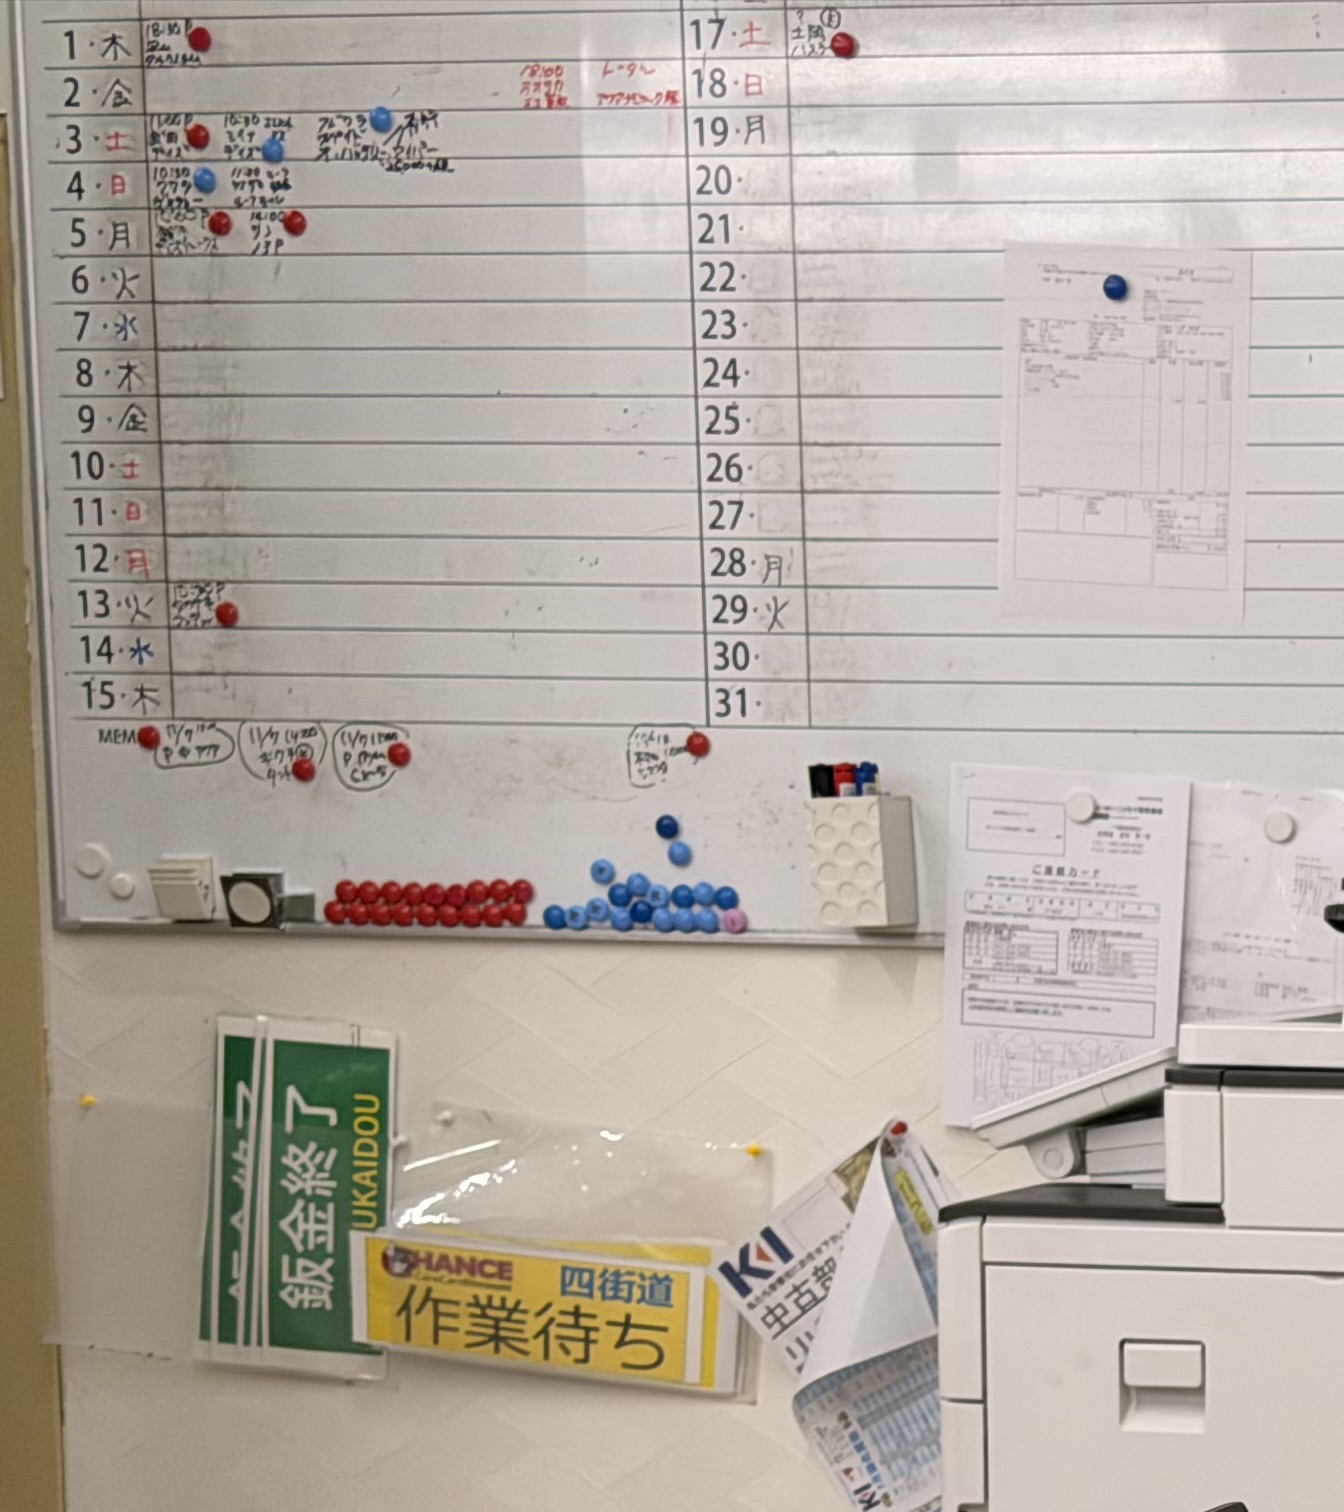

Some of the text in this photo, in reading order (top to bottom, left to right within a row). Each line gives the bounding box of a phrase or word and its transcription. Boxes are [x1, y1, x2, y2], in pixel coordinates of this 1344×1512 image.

[62, 29, 77, 61] 1
[689, 18, 726, 50] 17
[62, 75, 82, 108] 2
[692, 67, 728, 99] 18
[63, 123, 83, 156] 3
[693, 115, 730, 147] 19
[64, 169, 86, 200] 4
[695, 164, 733, 197] 20
[70, 216, 88, 246] 5
[696, 211, 732, 245] 21
[70, 264, 90, 295] 6
[698, 260, 737, 294] 22
[74, 311, 91, 340] 7
[699, 307, 739, 341] 23
[75, 357, 95, 388] 8
[702, 355, 742, 389] 24
[78, 404, 97, 433] 9
[703, 403, 743, 436] 25
[69, 450, 105, 482] 10
[705, 450, 745, 484] 26
[72, 496, 105, 526] 11
[706, 499, 745, 533] 27
[74, 543, 110, 574] 12
[709, 545, 748, 578] 28
[77, 588, 112, 620] 13
[710, 594, 749, 627] 29
[79, 634, 115, 664] 14
[712, 640, 752, 673] 30
[81, 679, 116, 711] 15
[714, 687, 748, 718] 31
[99, 728, 139, 745] MEM
[279, 1084, 338, 1311] 鈑金終了
[560, 1264, 674, 1308] 四街道
[395, 1284, 670, 1371] 作業待ち
